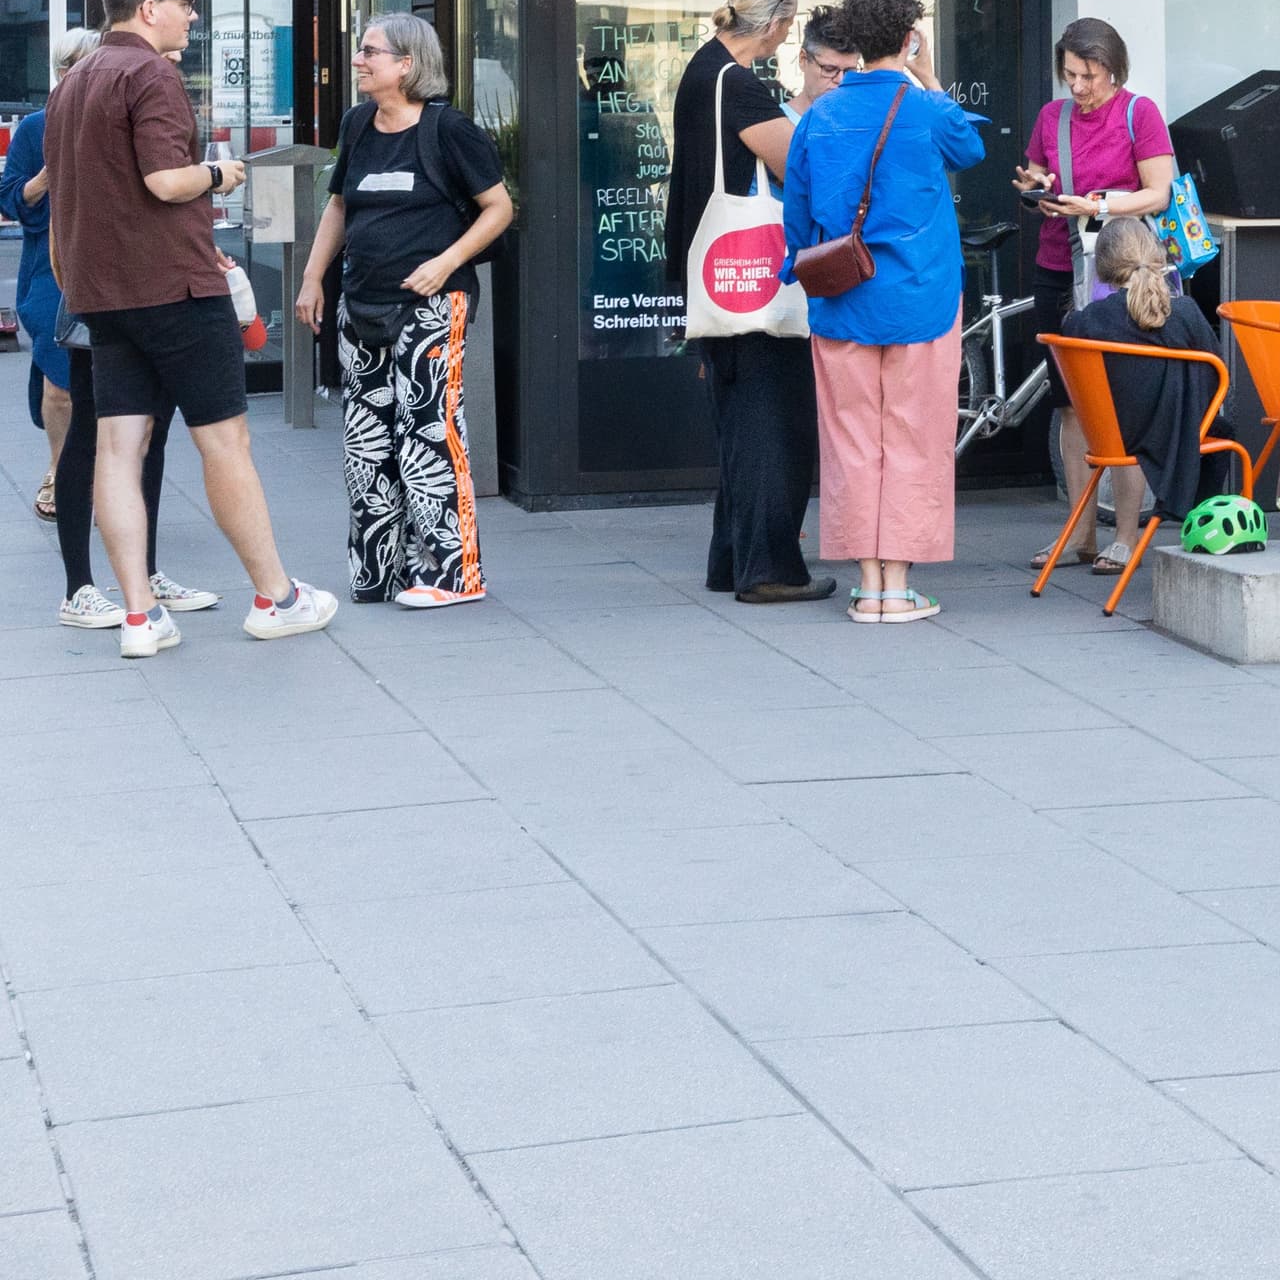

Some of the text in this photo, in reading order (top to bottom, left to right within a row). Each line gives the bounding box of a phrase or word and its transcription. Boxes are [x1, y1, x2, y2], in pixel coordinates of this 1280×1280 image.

[592, 23, 709, 53] THEATER
[945, 81, 990, 106] 16.07
[598, 210, 665, 235] AFTER
[714, 266, 775, 280] WIR. HIER.
[714, 280, 762, 293] MIT DIR.
[593, 293, 684, 309] Eure Verans
[593, 314, 688, 329] Schreibt uns
